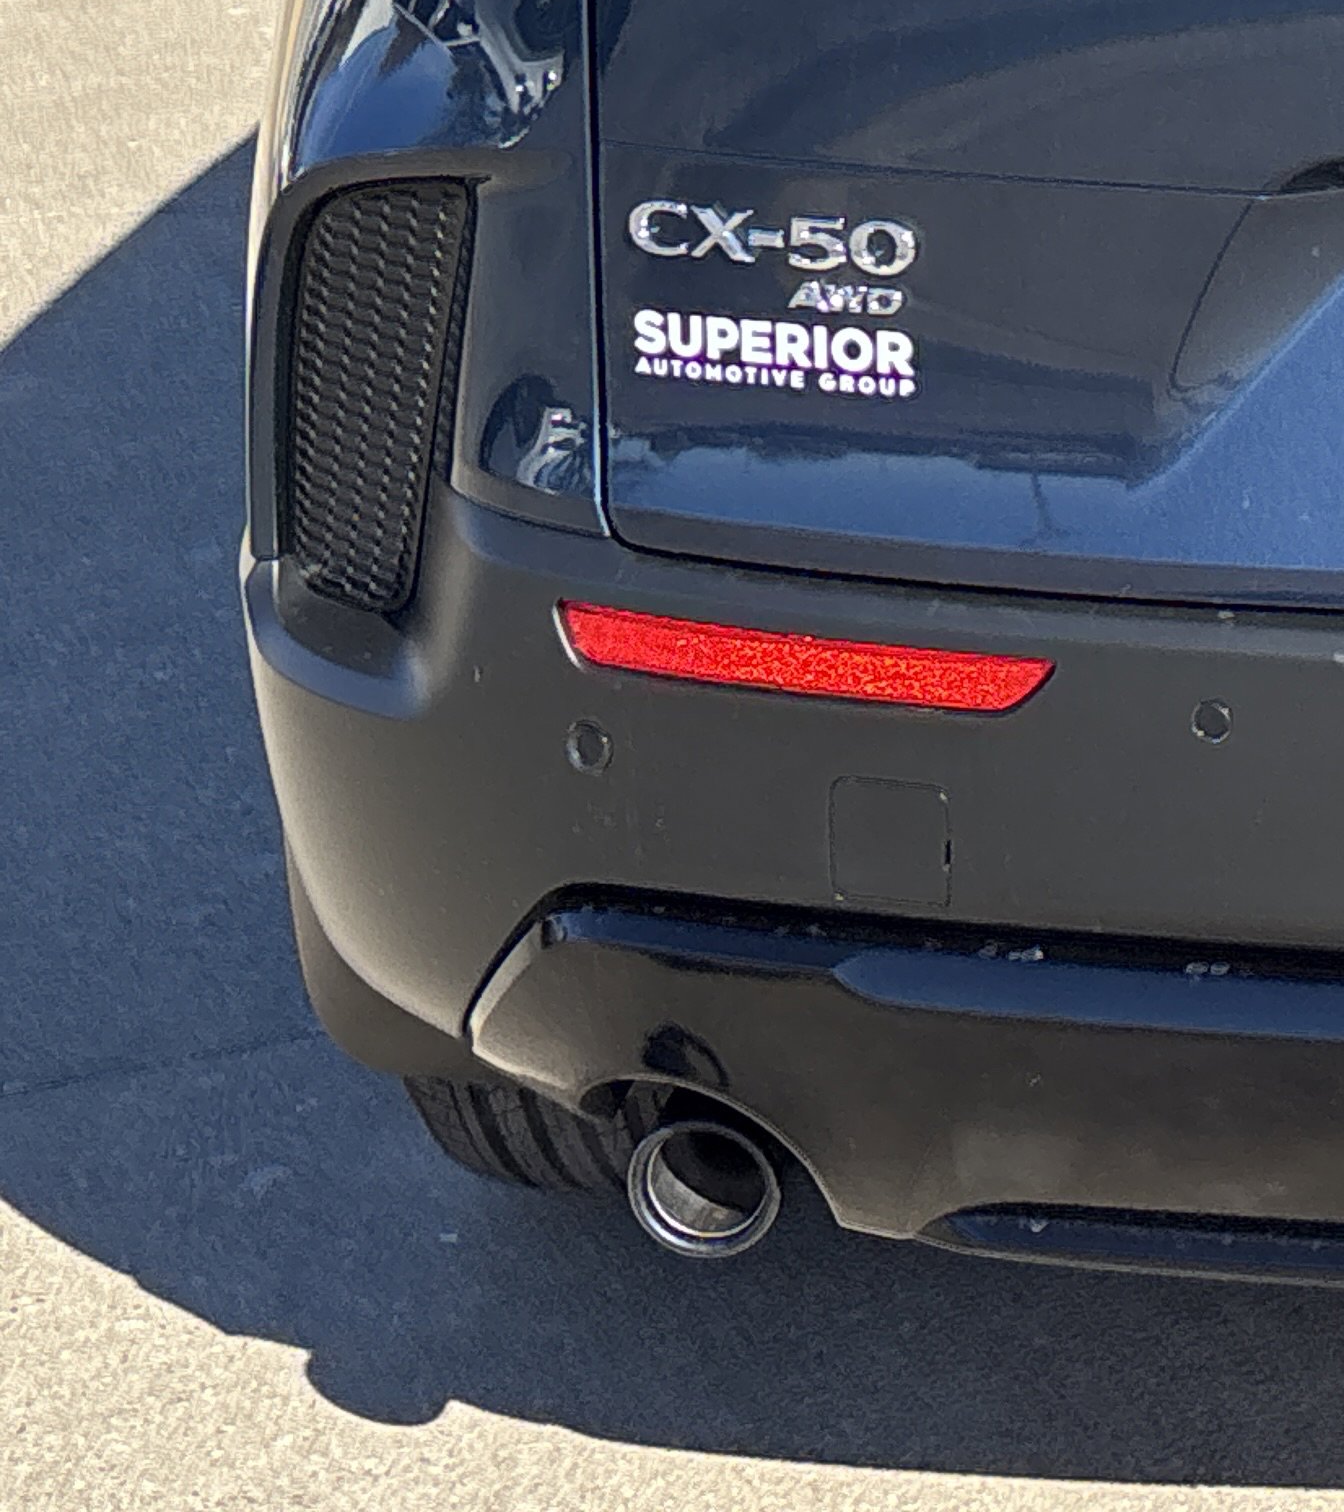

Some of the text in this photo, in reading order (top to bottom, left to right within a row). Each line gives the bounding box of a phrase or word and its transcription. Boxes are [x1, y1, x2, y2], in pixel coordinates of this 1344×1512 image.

[628, 200, 917, 276] CX-50
[788, 281, 907, 316] AWD
[633, 308, 915, 377] SUPERIOR
[633, 355, 917, 397] AUTOMOTIVE GROUP
